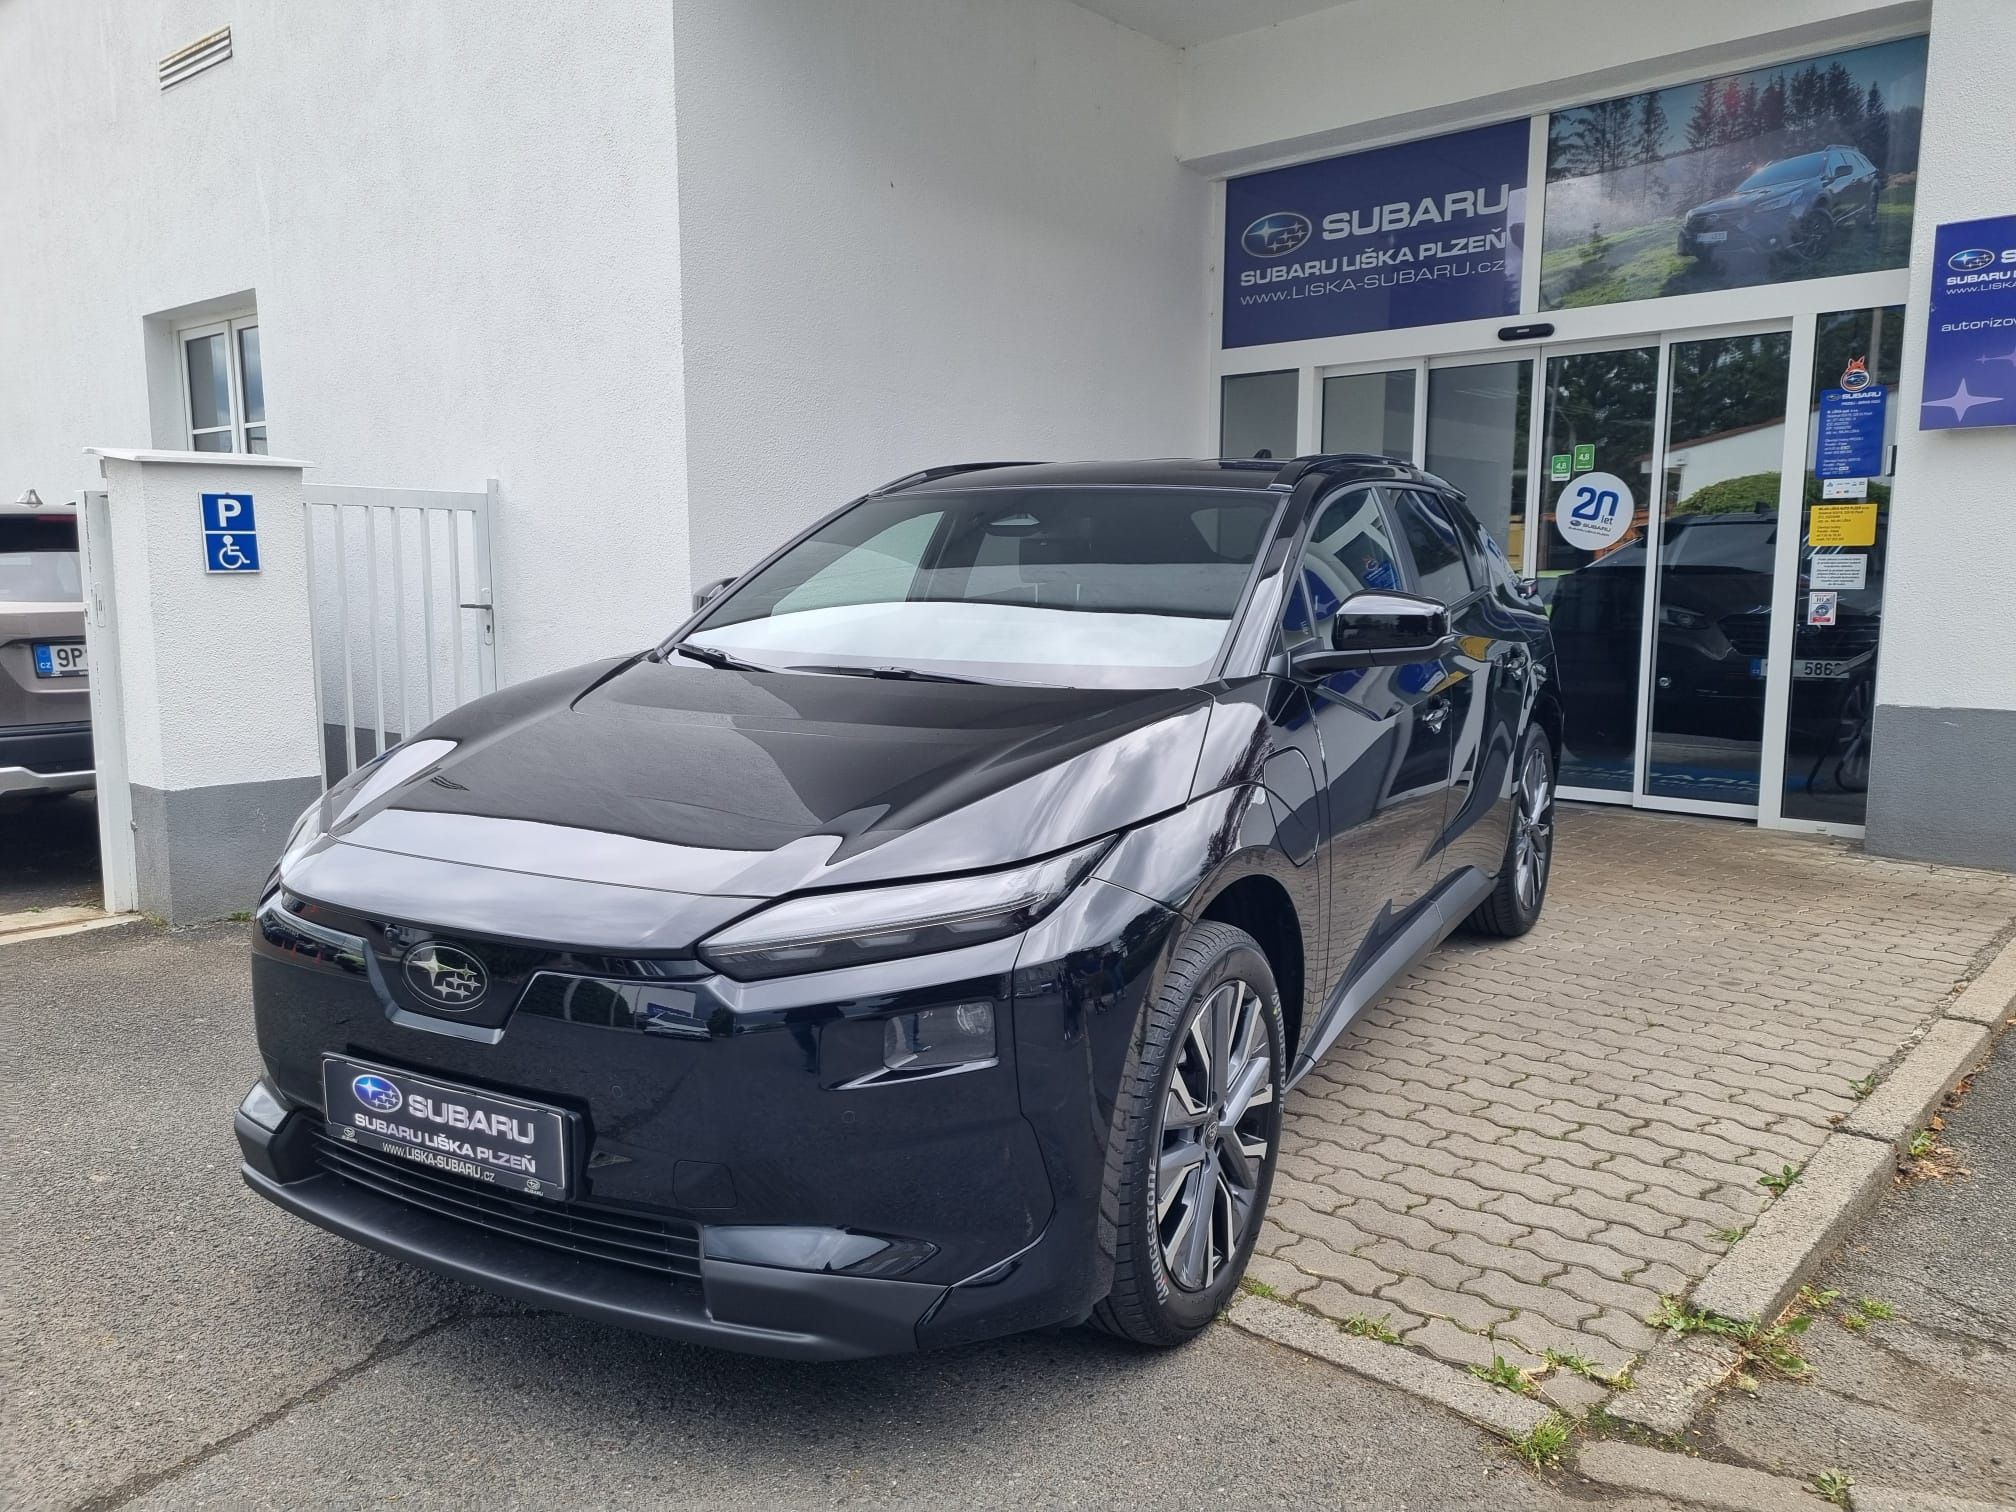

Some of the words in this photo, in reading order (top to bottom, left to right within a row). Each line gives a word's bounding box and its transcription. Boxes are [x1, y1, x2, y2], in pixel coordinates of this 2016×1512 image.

[1322, 184, 1509, 241] SUBARU
[1240, 258, 1338, 287] SUBARU
[1342, 246, 1414, 272] LIŠKA
[1419, 228, 1507, 261] PLZEŇ
[1947, 271, 2011, 285] SUBARU
[1240, 260, 1505, 305] www.LISKA-SUBARU.cz
[1842, 391, 1882, 400] SUBARU
[218, 498, 242, 527] P
[1582, 523, 1611, 532] SUBARU
[1600, 515, 1614, 526] let
[408, 1094, 535, 1145] SUBARU
[354, 1113, 422, 1143] SUBARU
[424, 1132, 475, 1158] LIŠKA
[476, 1146, 536, 1173] PLZEŇ
[382, 1142, 495, 1182] www.LISKA-SUBARU.cz
[1146, 1157, 1169, 1306] BRIDGESTONE
